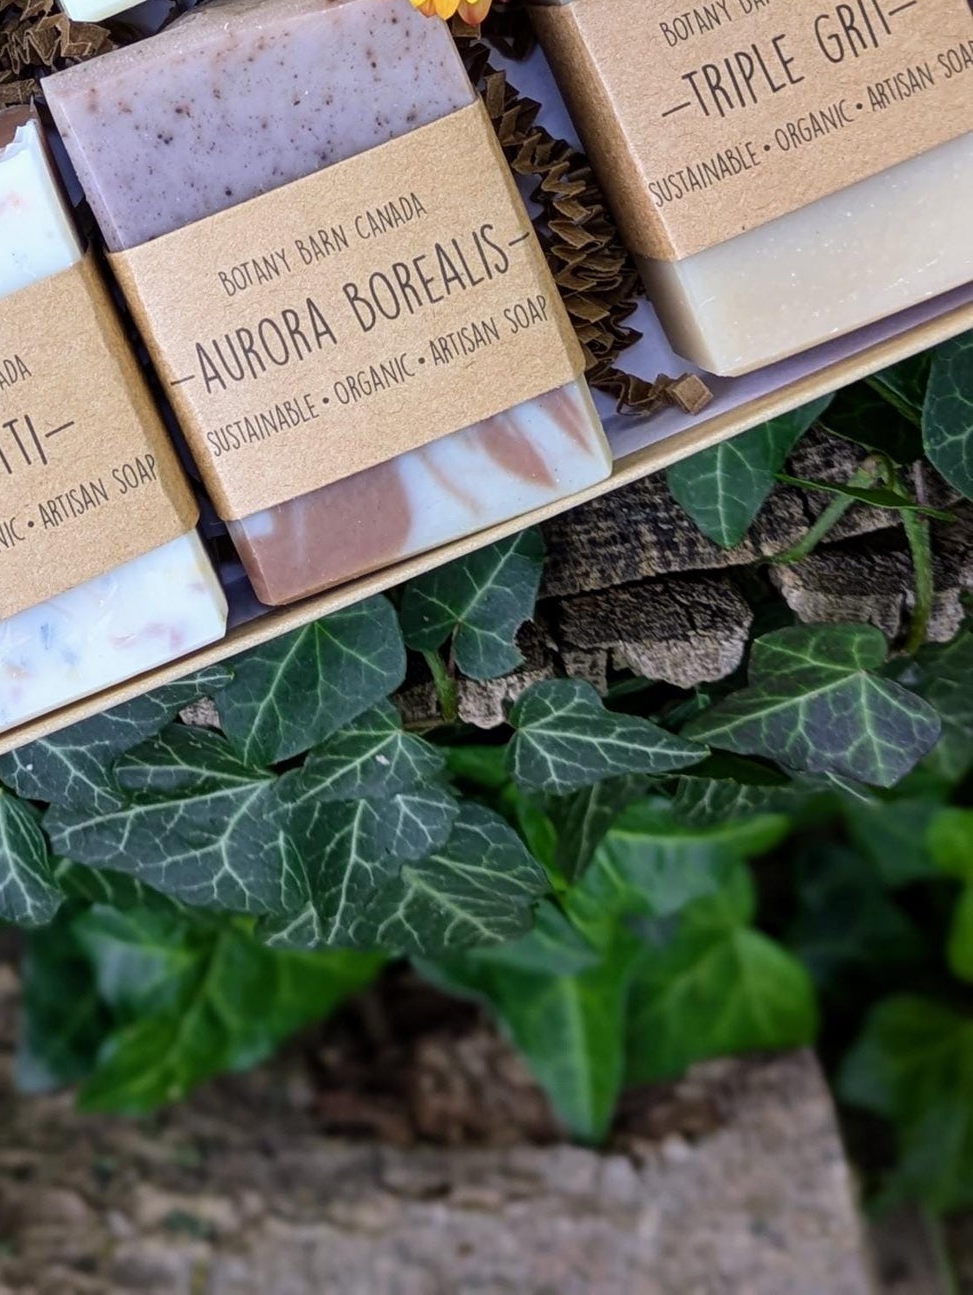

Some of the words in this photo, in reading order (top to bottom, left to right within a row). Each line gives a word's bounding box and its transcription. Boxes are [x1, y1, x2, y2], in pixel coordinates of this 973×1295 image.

[648, 142, 761, 208] SUSTAINABLE
[774, 99, 854, 151] ORGANIC
[866, 62, 935, 112] ARTISAN
[218, 248, 291, 297] BOTANY
[294, 224, 348, 265] BARN
[355, 193, 427, 239] CANADA
[206, 394, 319, 457] SUSTAINABLE
[333, 353, 415, 405] ORGANIC
[429, 319, 500, 366] ARTISAN
[504, 295, 549, 334] SOAP
[38, 479, 109, 530] ARTISAN
[112, 453, 158, 494] SOAP
